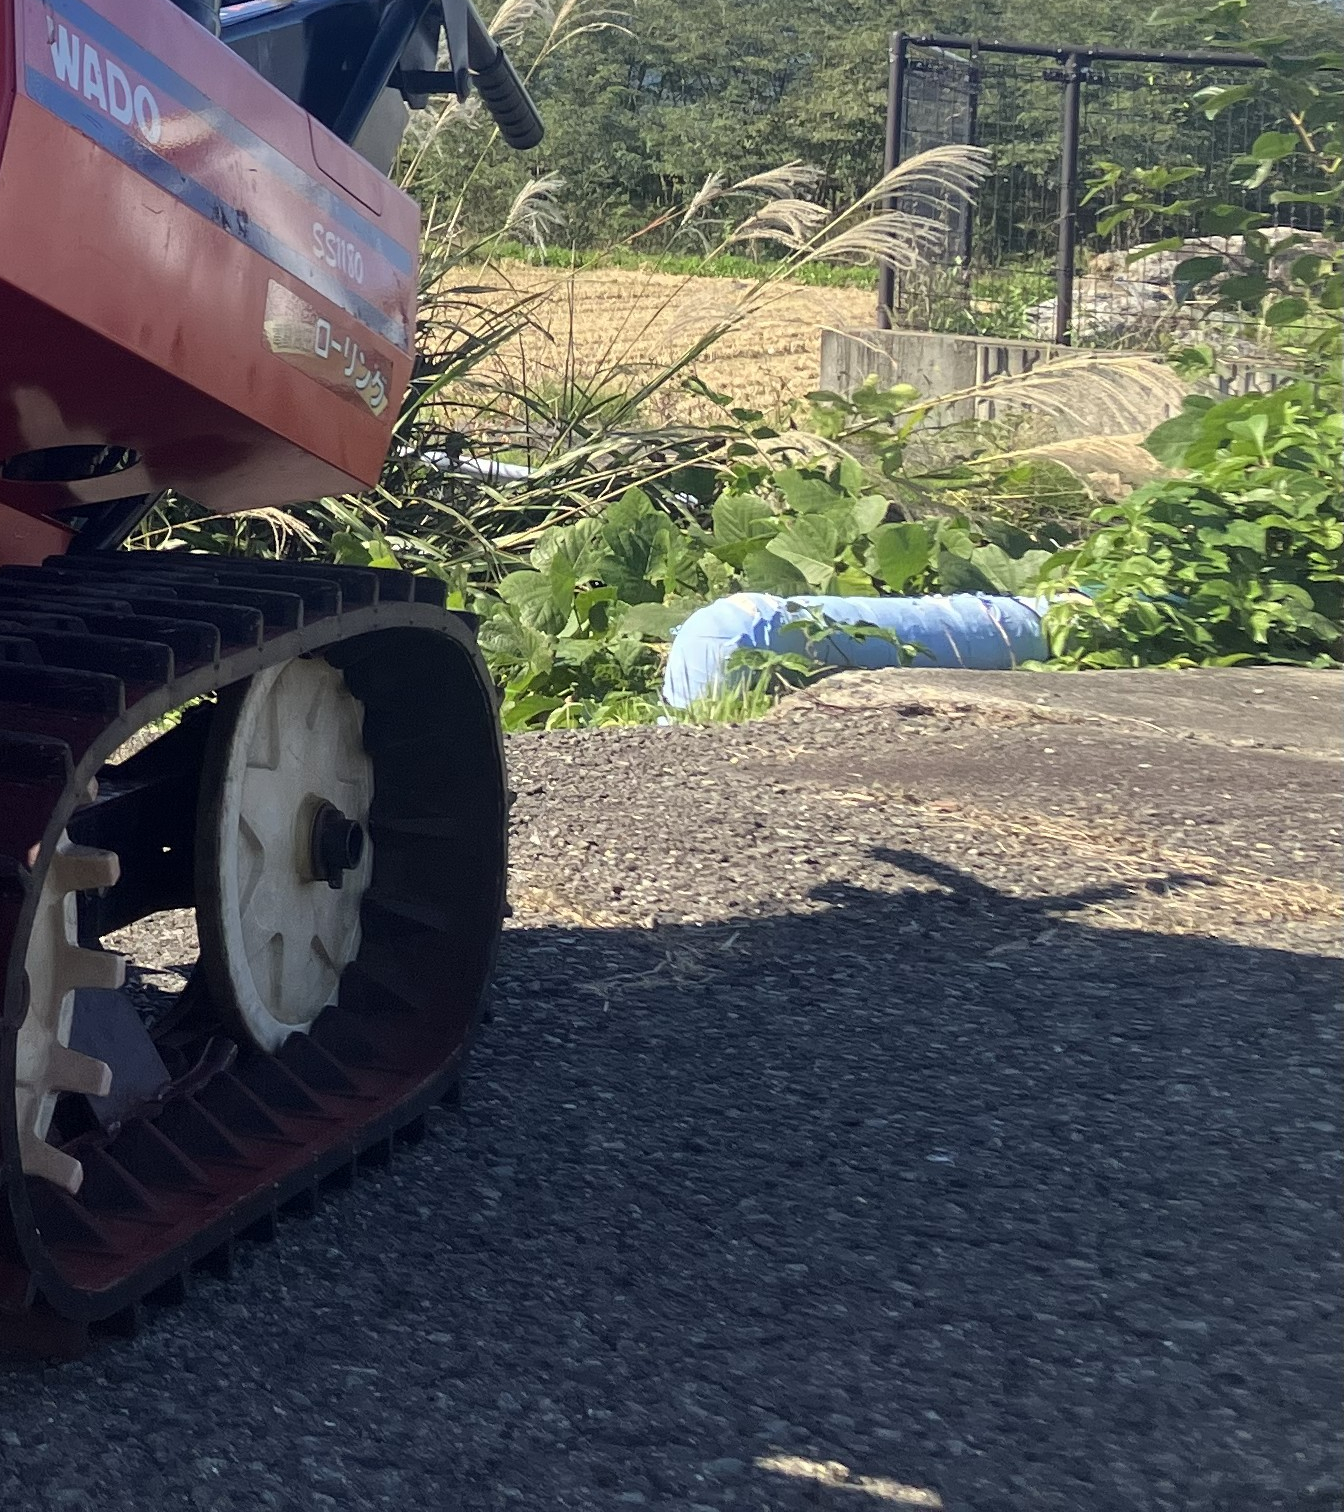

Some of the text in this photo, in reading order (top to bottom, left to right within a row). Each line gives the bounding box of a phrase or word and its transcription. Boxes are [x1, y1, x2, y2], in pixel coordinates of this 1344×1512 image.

[46, 15, 161, 144] WADO
[312, 222, 364, 284] SS1180
[315, 317, 388, 407] ローリング
